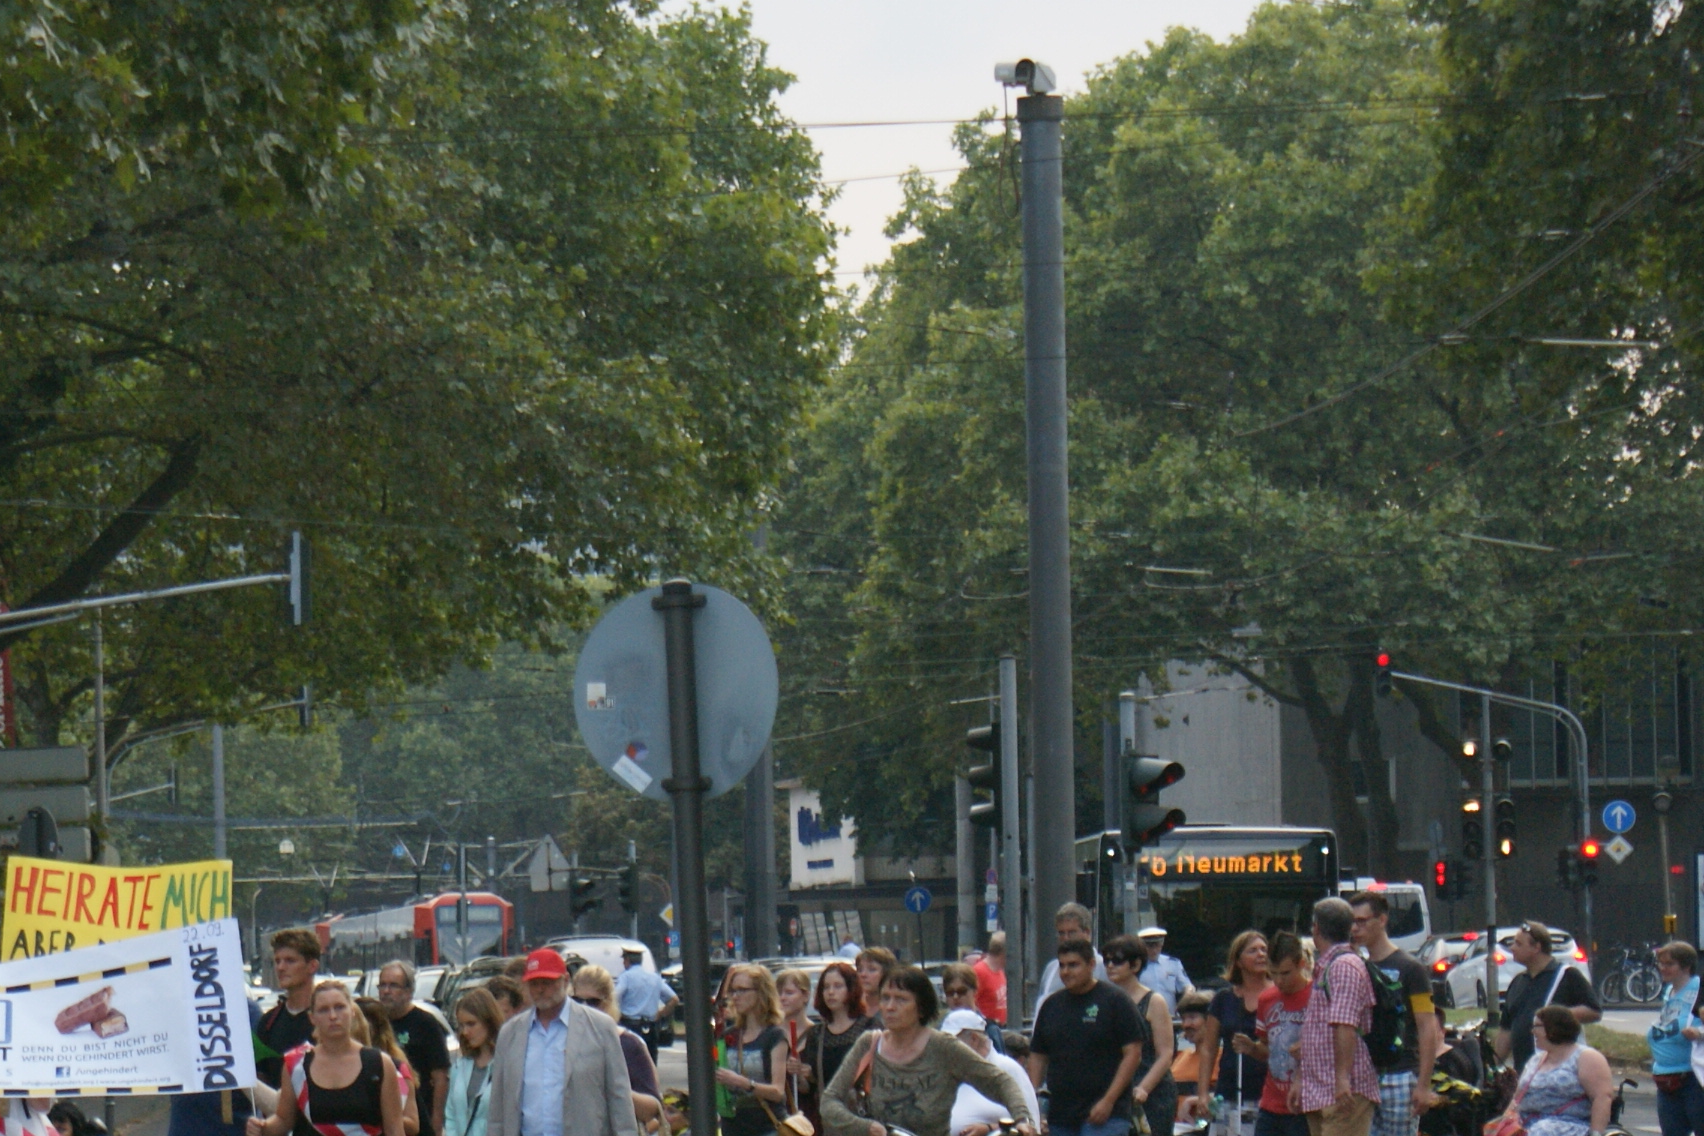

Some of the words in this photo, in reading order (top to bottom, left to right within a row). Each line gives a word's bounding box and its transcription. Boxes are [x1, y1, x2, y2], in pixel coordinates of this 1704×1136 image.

[1177, 852, 1303, 874] Neumarkt
[10, 866, 161, 930] HEIRATE
[161, 870, 230, 930] MICH
[188, 942, 239, 1090] DÜSSELDORF
[21, 1045, 53, 1054] DENN
[61, 1044, 77, 1053] DU
[83, 1042, 108, 1052] BIST
[114, 1036, 147, 1049] NICHT
[153, 1032, 169, 1043] DU
[21, 1054, 55, 1063] WENN
[57, 1054, 72, 1062] DU
[75, 1049, 134, 1062] GEHINDERT
[75, 1065, 139, 1078] /ungehindert
